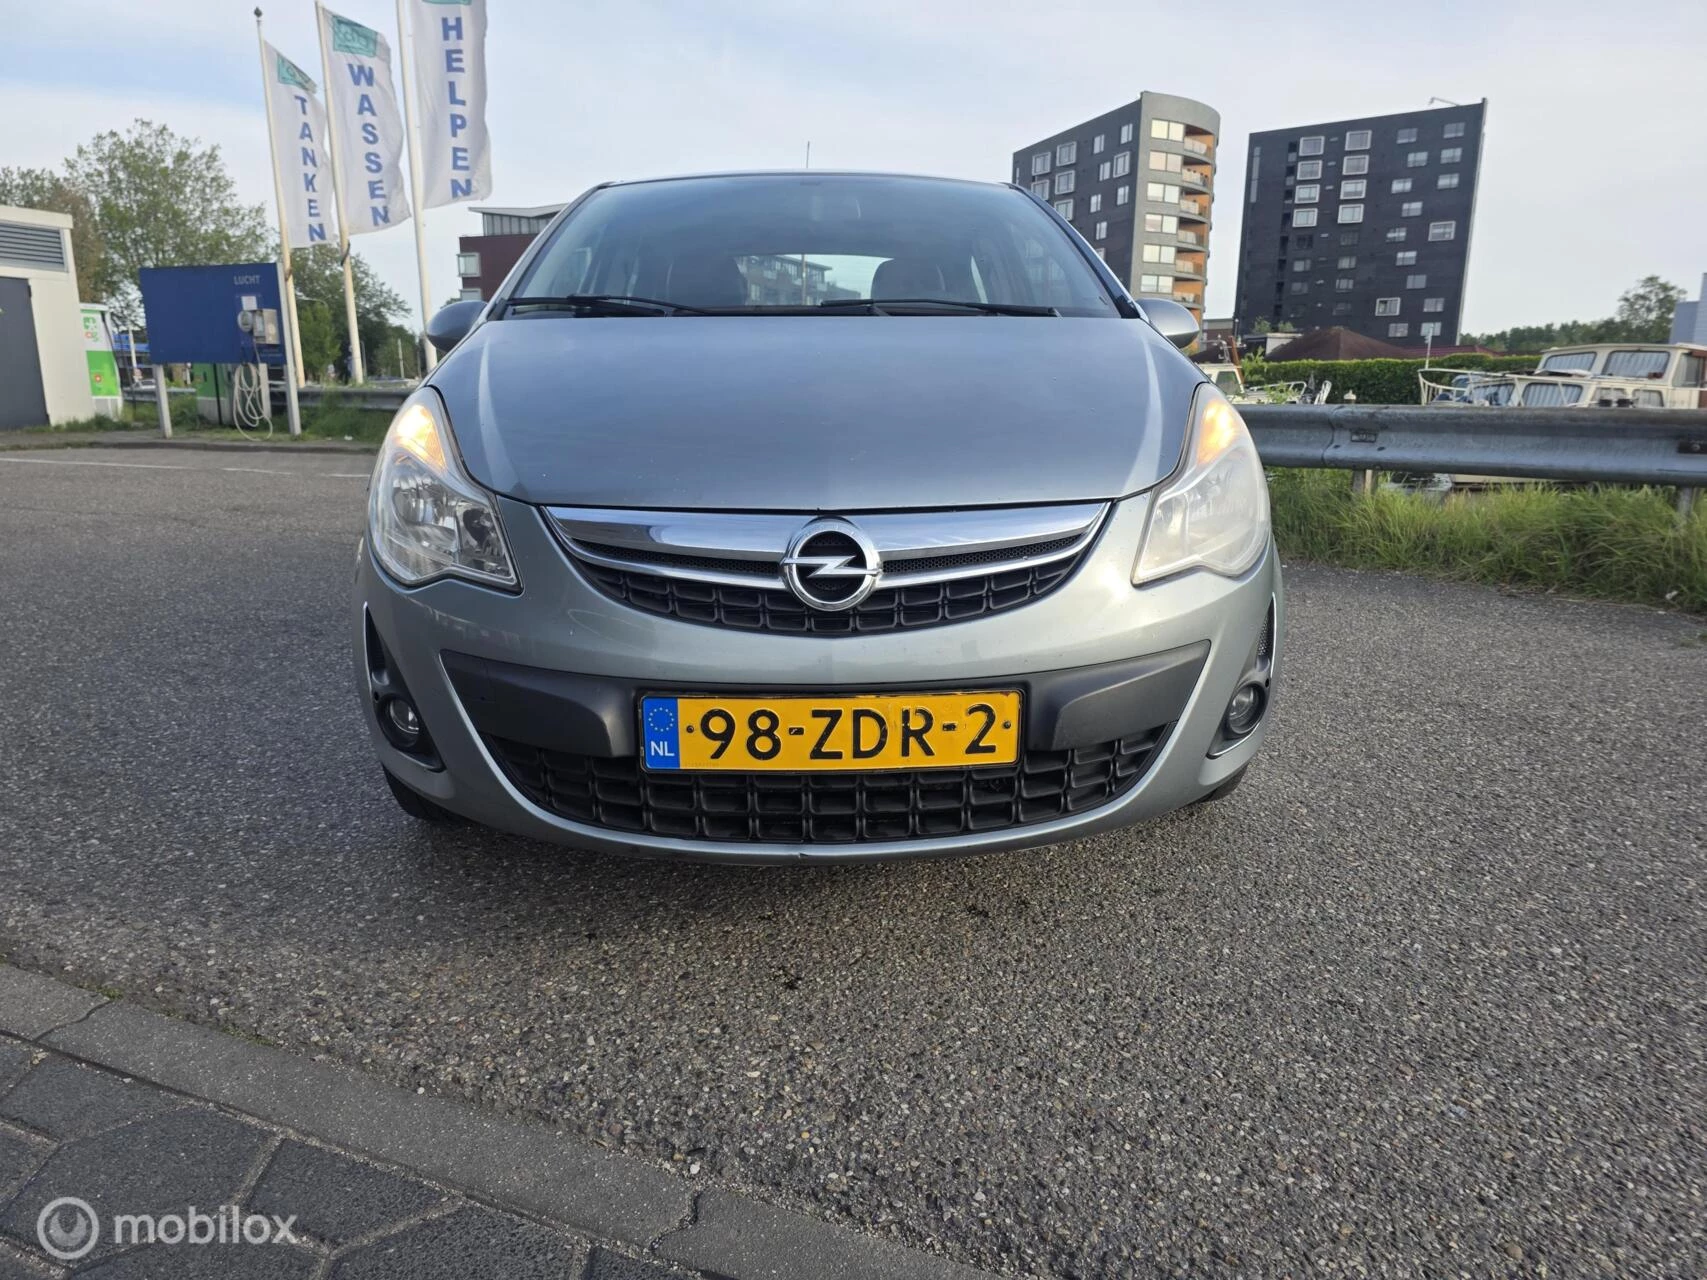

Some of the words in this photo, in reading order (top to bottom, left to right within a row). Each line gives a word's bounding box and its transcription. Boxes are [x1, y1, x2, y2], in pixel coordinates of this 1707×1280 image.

[347, 63, 391, 227] WASSEN
[441, 16, 472, 199] HELPEN
[294, 95, 327, 242] TANKEN
[233, 275, 260, 285] LUCHT
[650, 741, 675, 757] NL
[699, 703, 997, 761] 98-ZDR-2
